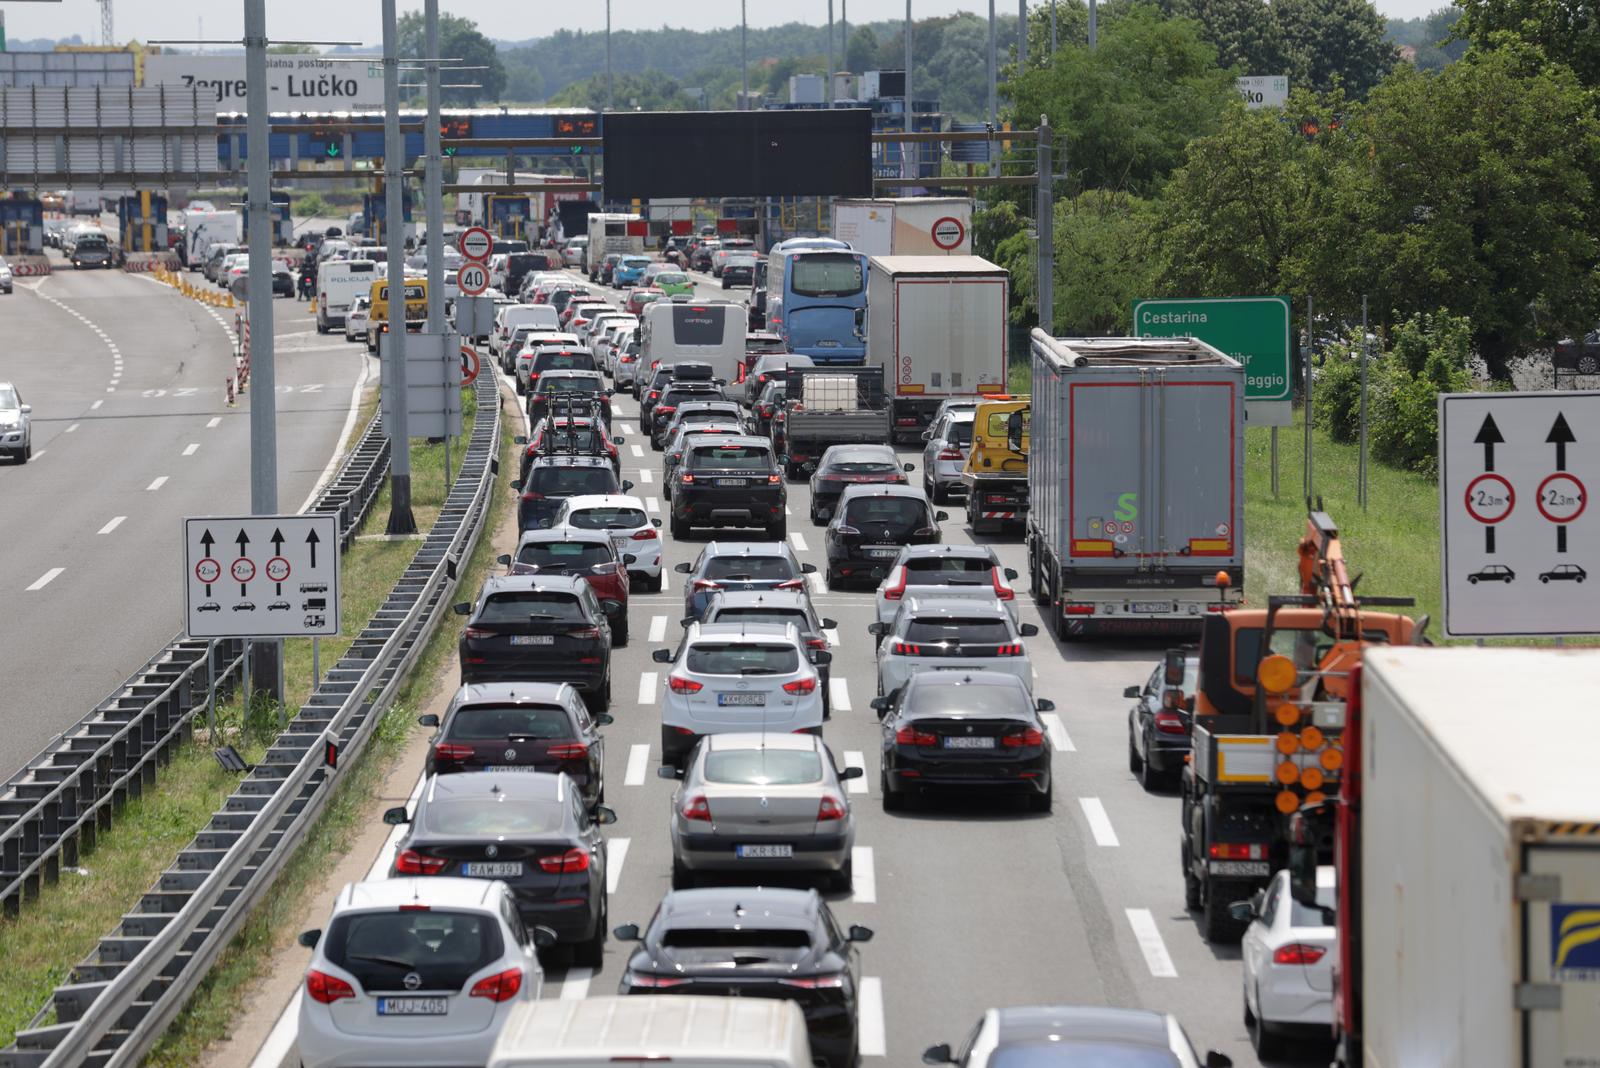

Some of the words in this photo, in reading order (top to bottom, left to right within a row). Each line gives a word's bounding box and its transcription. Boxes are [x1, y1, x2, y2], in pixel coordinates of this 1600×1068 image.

[288, 74, 358, 97] Lučko
[464, 271, 483, 287] 40
[1142, 311, 1208, 324] Cestarina
